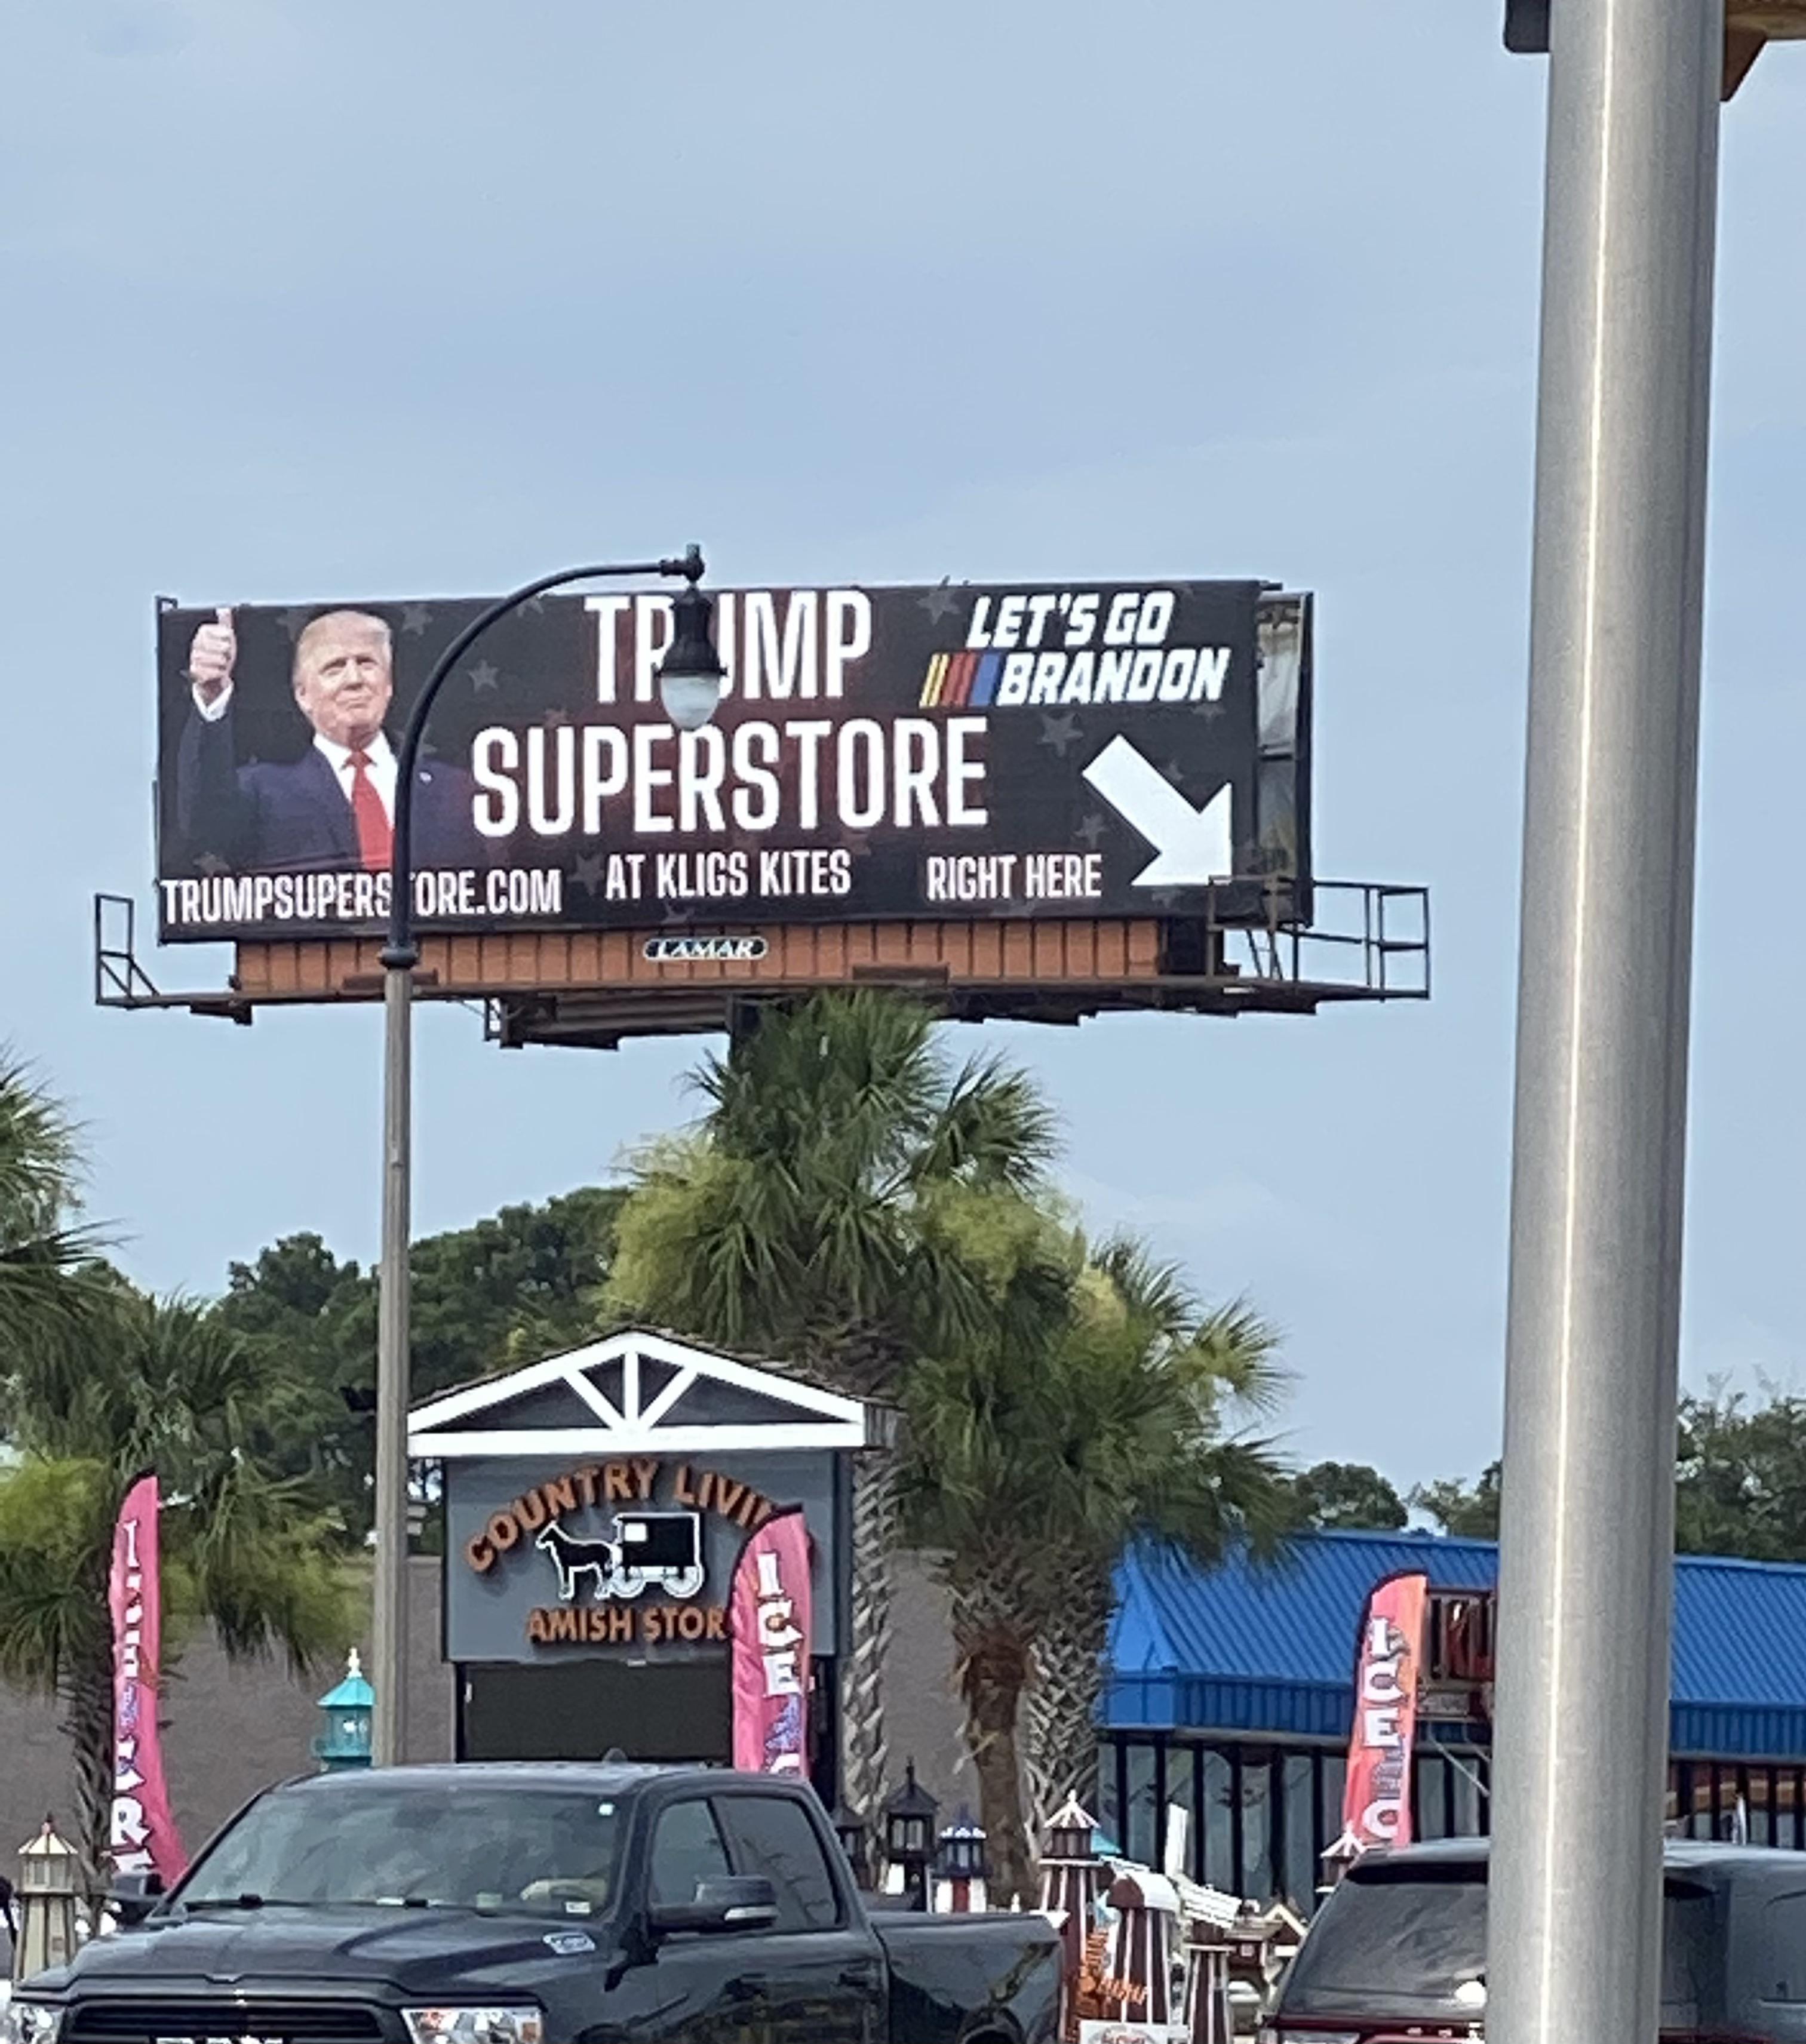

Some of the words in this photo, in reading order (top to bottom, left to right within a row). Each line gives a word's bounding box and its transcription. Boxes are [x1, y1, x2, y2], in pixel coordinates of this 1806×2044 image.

[965, 594, 1099, 648] LET'S
[1102, 591, 1175, 646] GO
[996, 647, 1231, 707] BRANDON
[472, 716, 988, 837] SUPERSTORE
[161, 868, 562, 923] TRUMPSUPERSORE.COM
[605, 854, 644, 899] AT
[656, 850, 749, 898] KLIGS
[760, 849, 852, 896] KITES
[926, 855, 1016, 901] RIGHT
[1024, 854, 1102, 897] HERE
[658, 938, 755, 959] LAMAR
[466, 1459, 658, 1573] COUNTRY
[527, 1607, 634, 1643] AMISH
[643, 1606, 728, 1642] STOR
[757, 1552, 804, 1698] ICE
[1364, 1617, 1403, 1747] ICE
